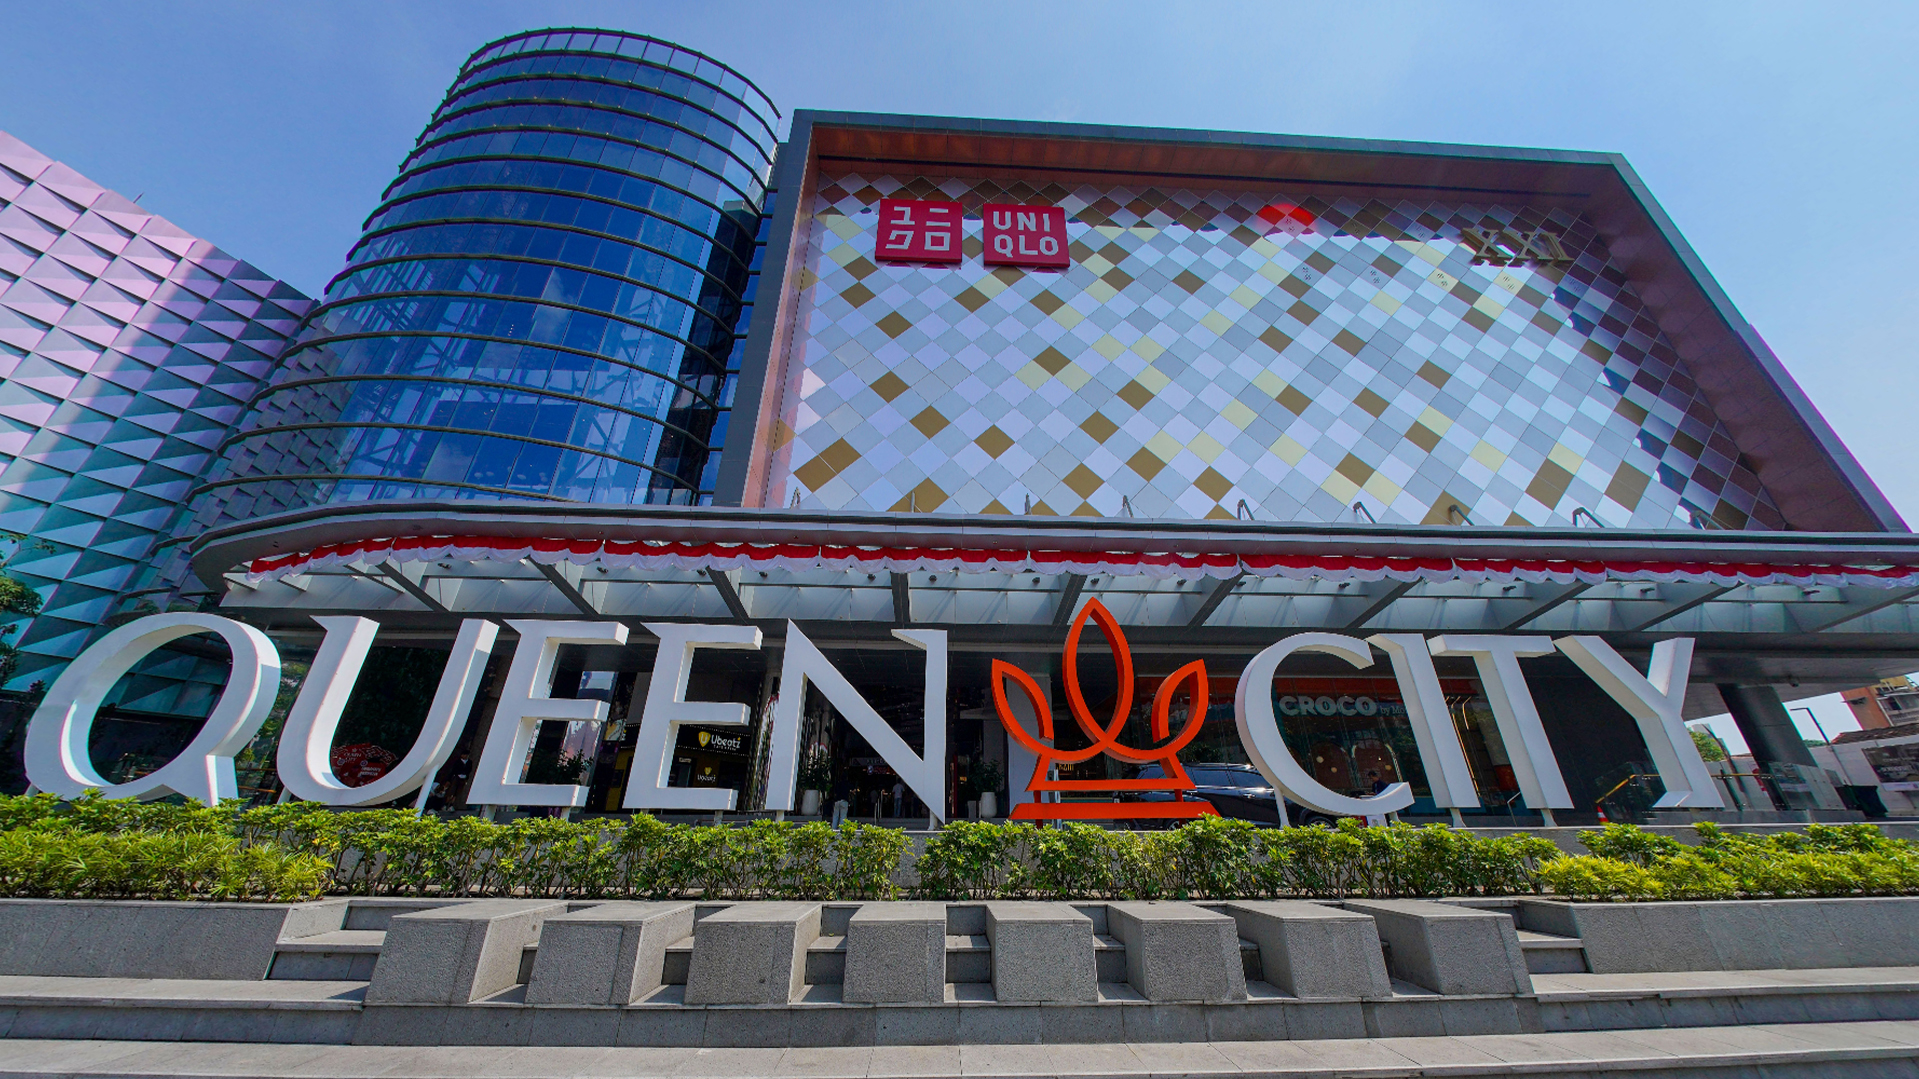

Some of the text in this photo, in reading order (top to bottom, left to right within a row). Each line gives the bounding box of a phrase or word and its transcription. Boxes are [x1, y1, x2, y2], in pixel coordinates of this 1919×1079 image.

[890, 206, 950, 227] ユニ
[993, 211, 1051, 232] UNI
[885, 230, 950, 252] クロ
[993, 234, 1059, 258] QLO
[1279, 695, 1377, 716] CROCO
[24, 611, 1726, 823] QUEEN CITY
